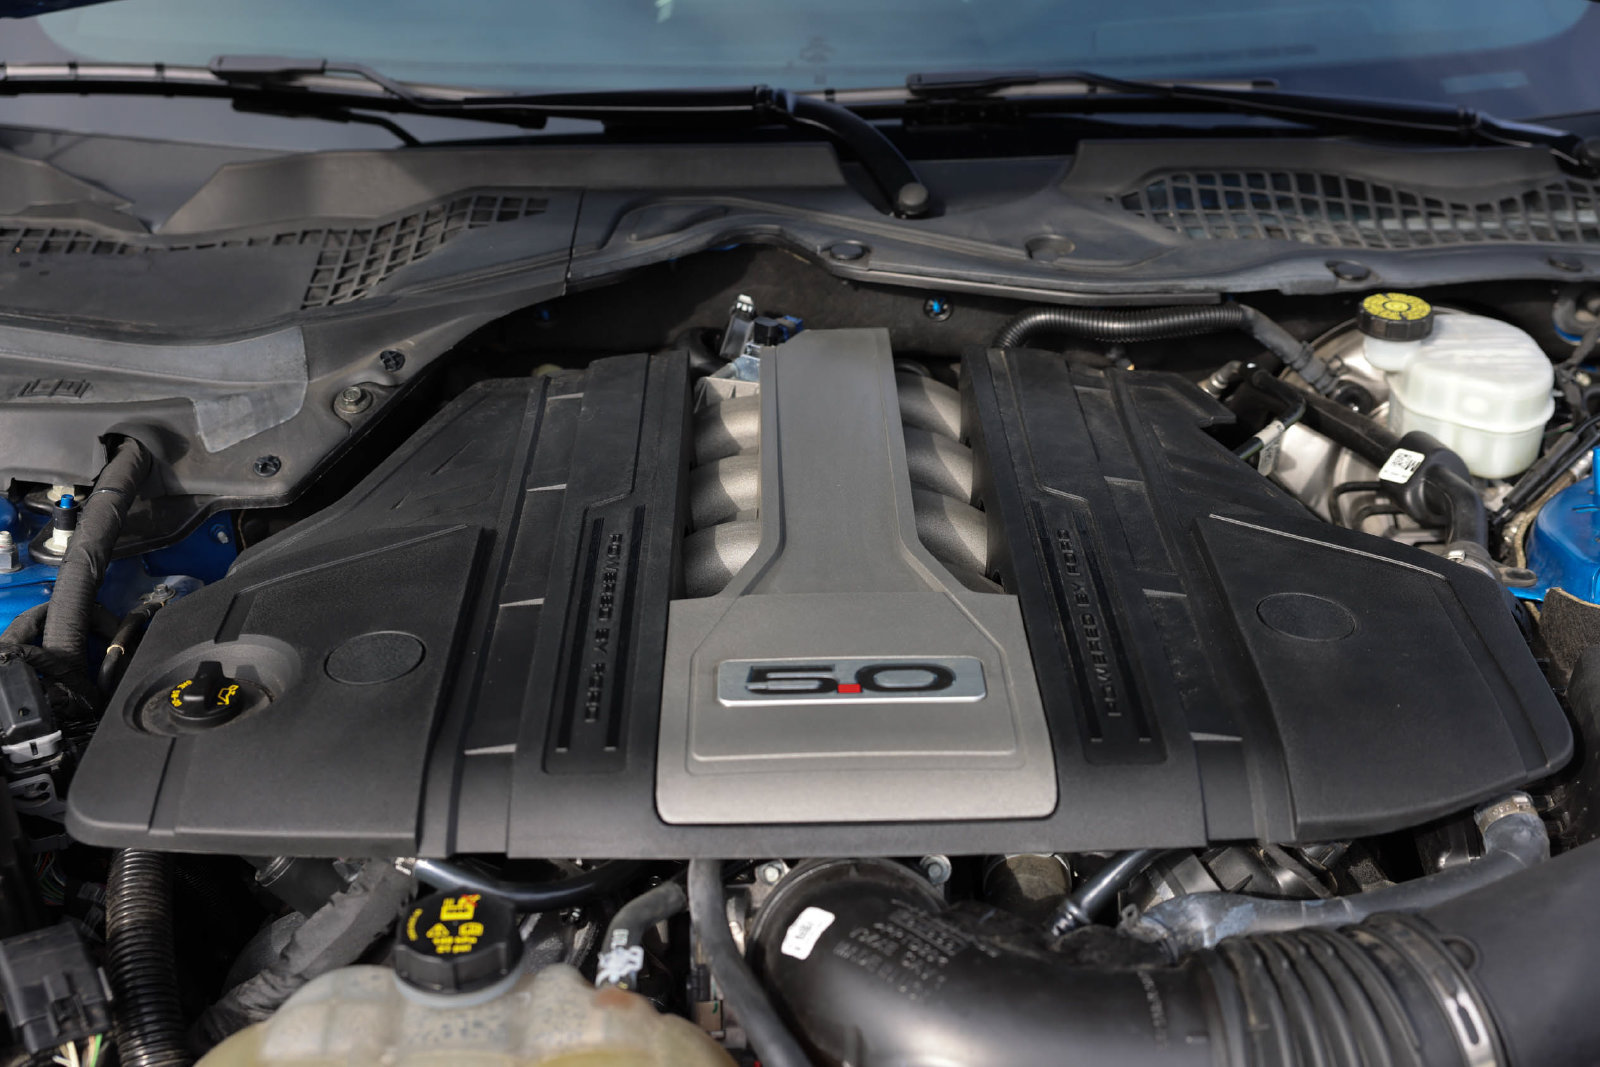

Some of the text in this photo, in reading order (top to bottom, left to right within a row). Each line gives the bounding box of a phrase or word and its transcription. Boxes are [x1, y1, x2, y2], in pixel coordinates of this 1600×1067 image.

[584, 533, 623, 723] POWERED BY FORD
[745, 662, 957, 695] 5.0
[1057, 528, 1122, 717] POWERED BY FORD
